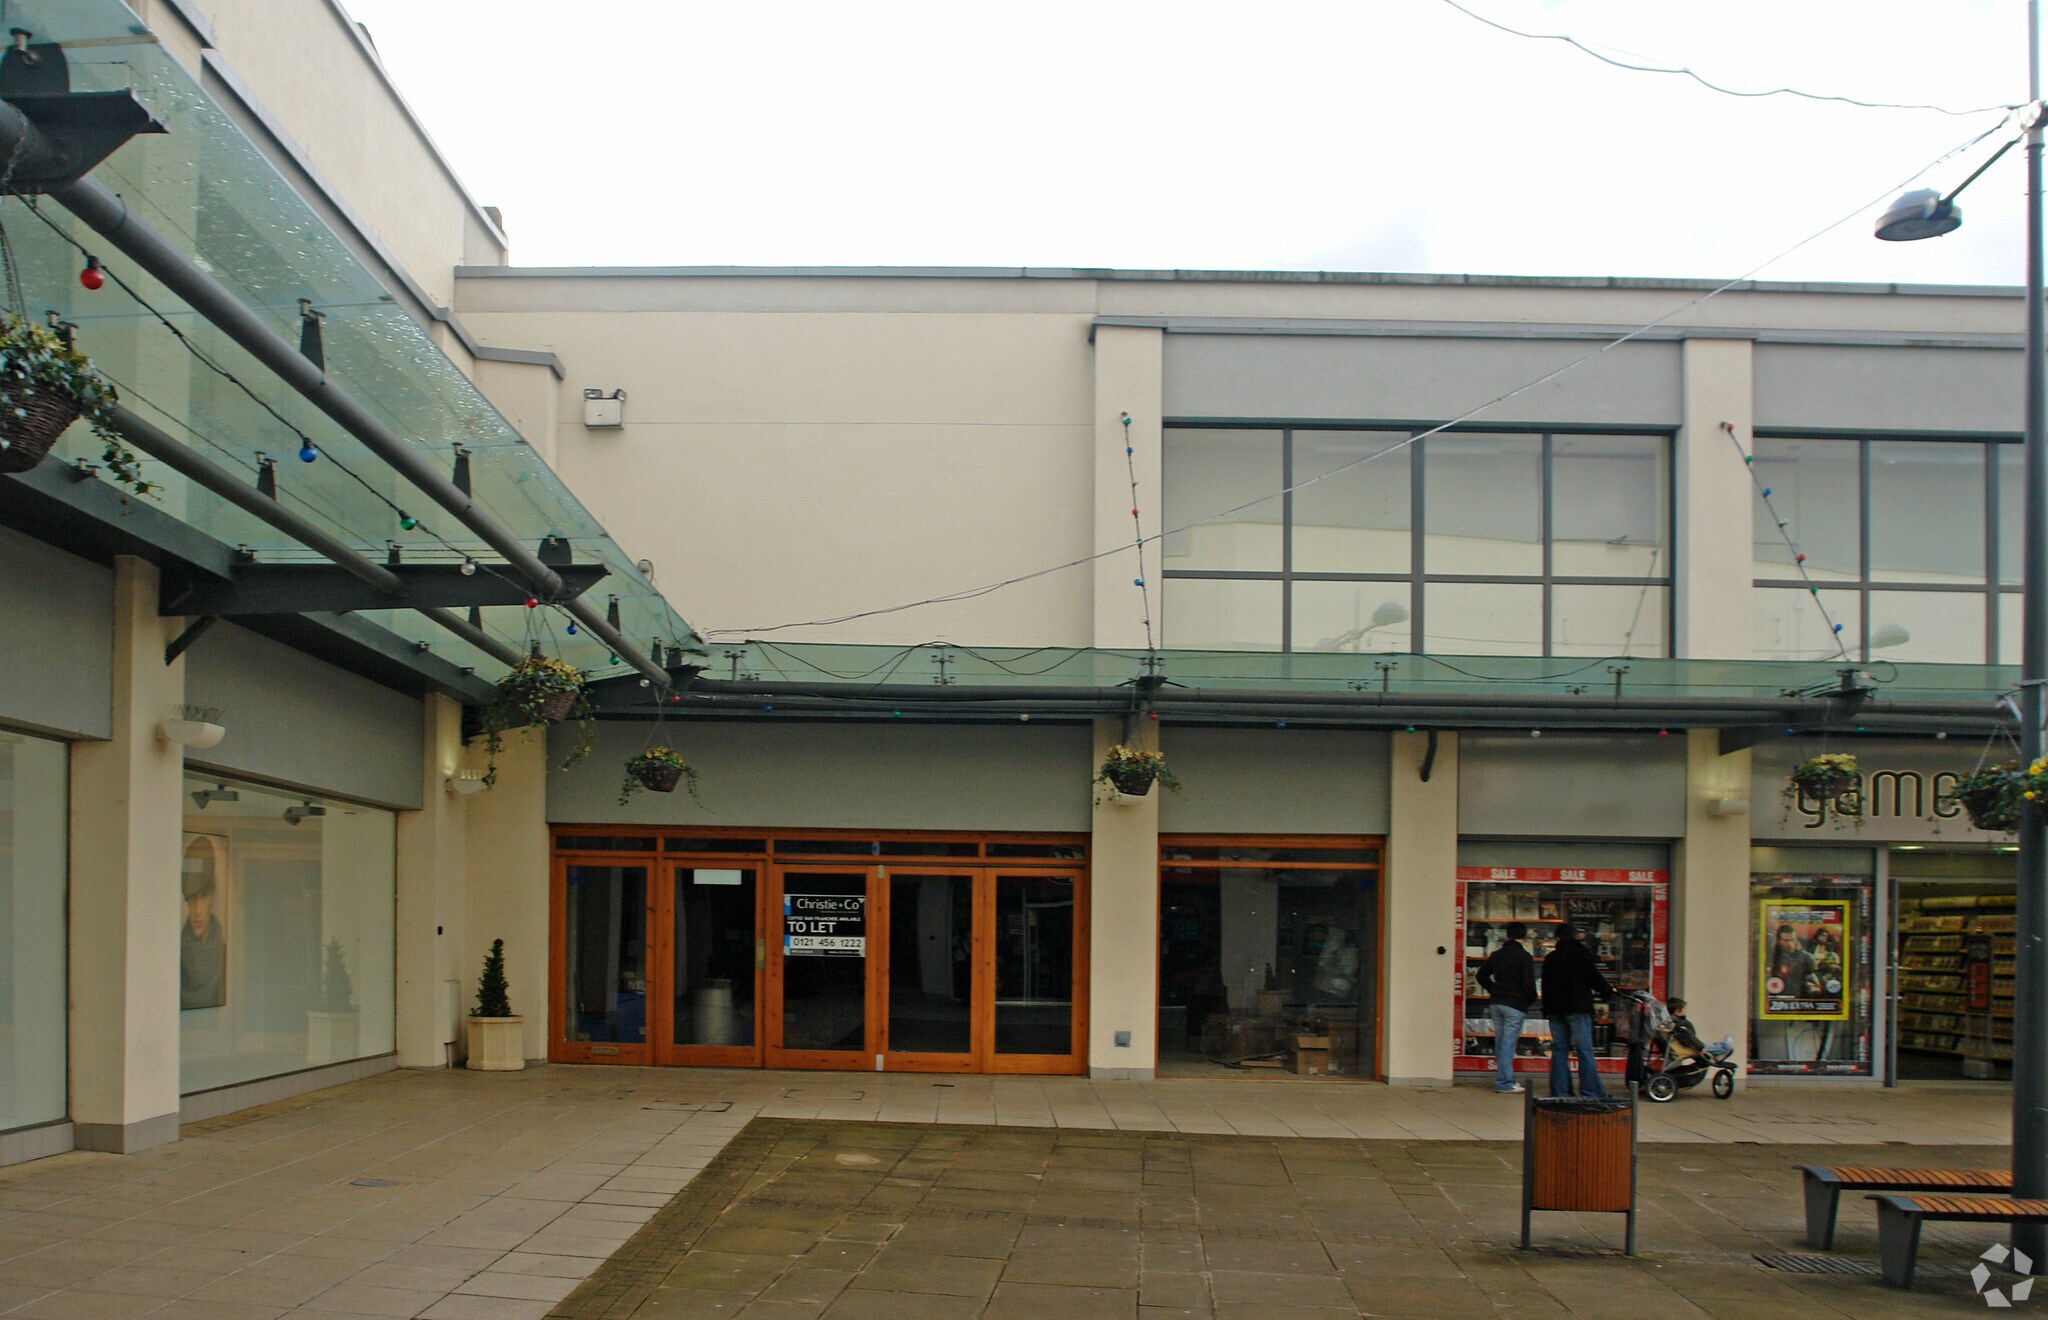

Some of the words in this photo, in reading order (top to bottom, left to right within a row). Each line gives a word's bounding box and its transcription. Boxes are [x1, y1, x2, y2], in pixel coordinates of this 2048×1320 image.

[1490, 868, 1517, 879] SALE
[1559, 869, 1586, 881] SALE
[1628, 871, 1655, 882] SALE
[787, 921, 807, 933] TO
[810, 921, 837, 933] LET
[793, 937, 814, 947] 0121
[818, 938, 836, 948] 456
[840, 938, 862, 948] 1222
[1654, 943, 1666, 967] SALE
